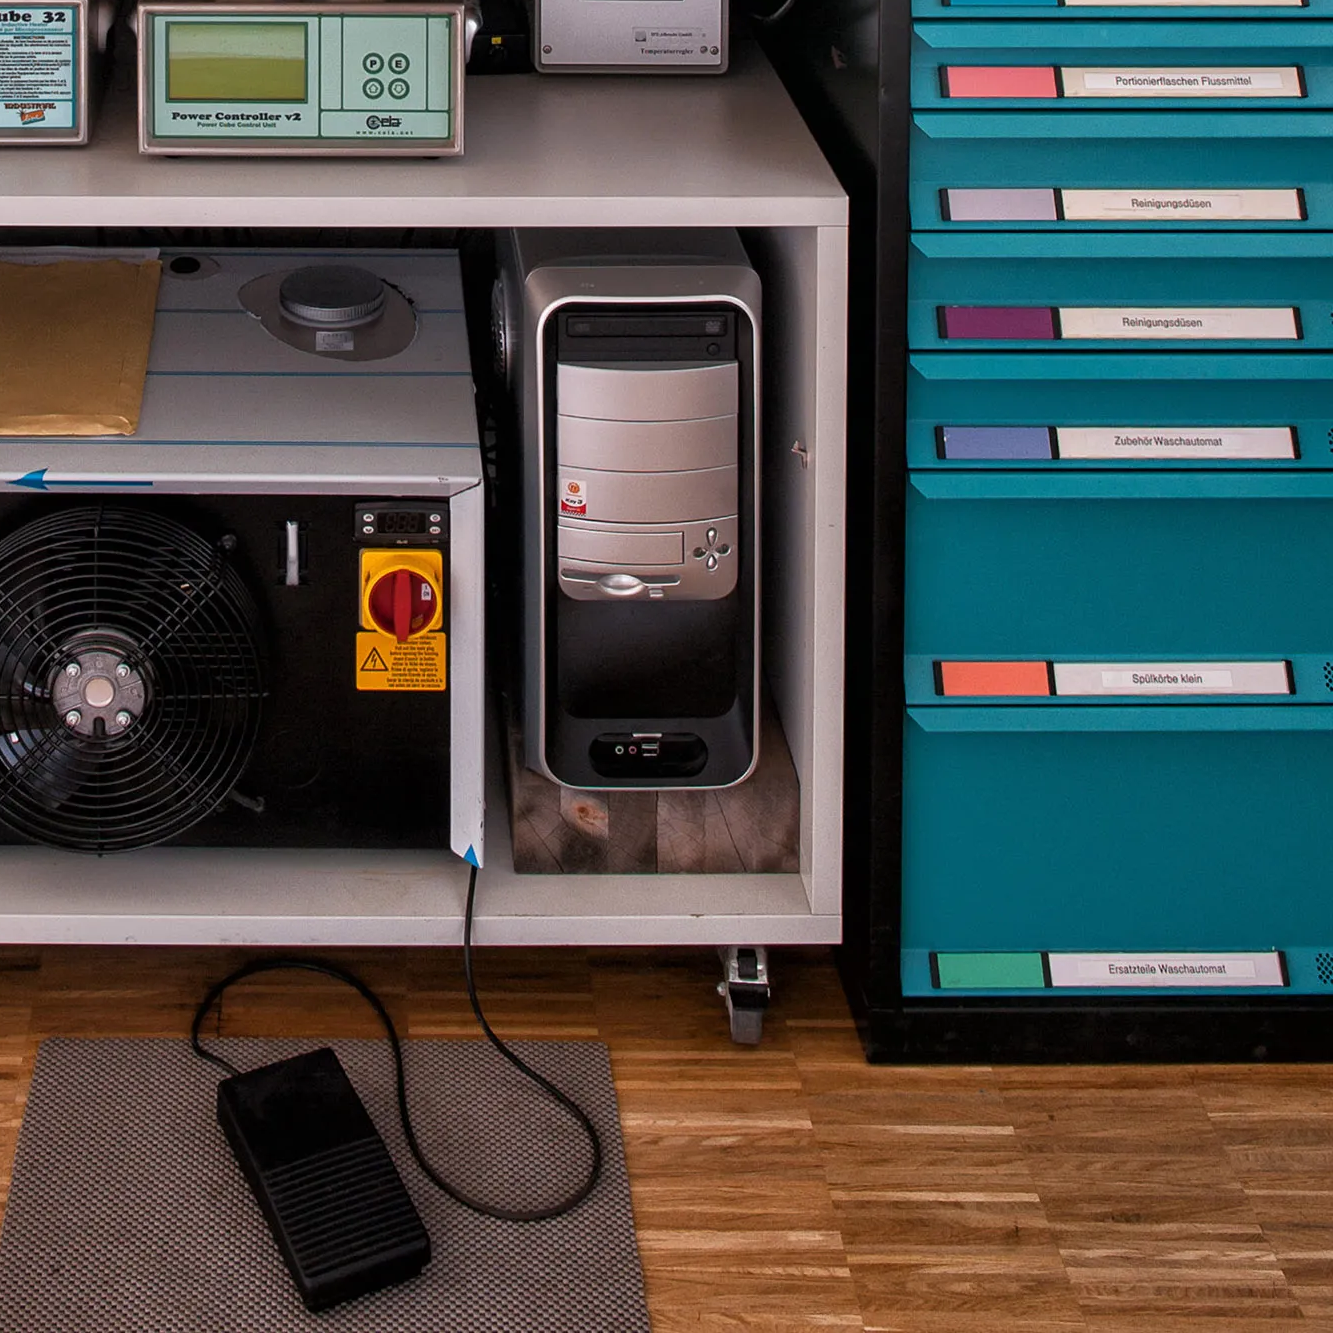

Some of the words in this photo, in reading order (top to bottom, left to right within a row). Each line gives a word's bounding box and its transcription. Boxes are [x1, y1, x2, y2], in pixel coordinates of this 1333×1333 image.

[42, 11, 66, 23] 32
[369, 59, 377, 68] P
[394, 59, 402, 68] E
[1115, 75, 1200, 87] Portionierflaschen
[1201, 75, 1252, 87] Flussmittel
[172, 112, 212, 121] Power
[215, 112, 282, 121] Controller
[285, 112, 302, 121] v2
[1130, 198, 1212, 211] Reinigungsdüsen
[1122, 316, 1203, 329] Reinigungsdüsen
[1114, 435, 1153, 447] Zubehör
[1153, 436, 1223, 447] Waschautomat
[1132, 673, 1179, 686] Spülkörbe
[1180, 673, 1203, 684] klein
[1108, 963, 1156, 975] Ersatzteile
[1158, 964, 1227, 975] Waschautomat
